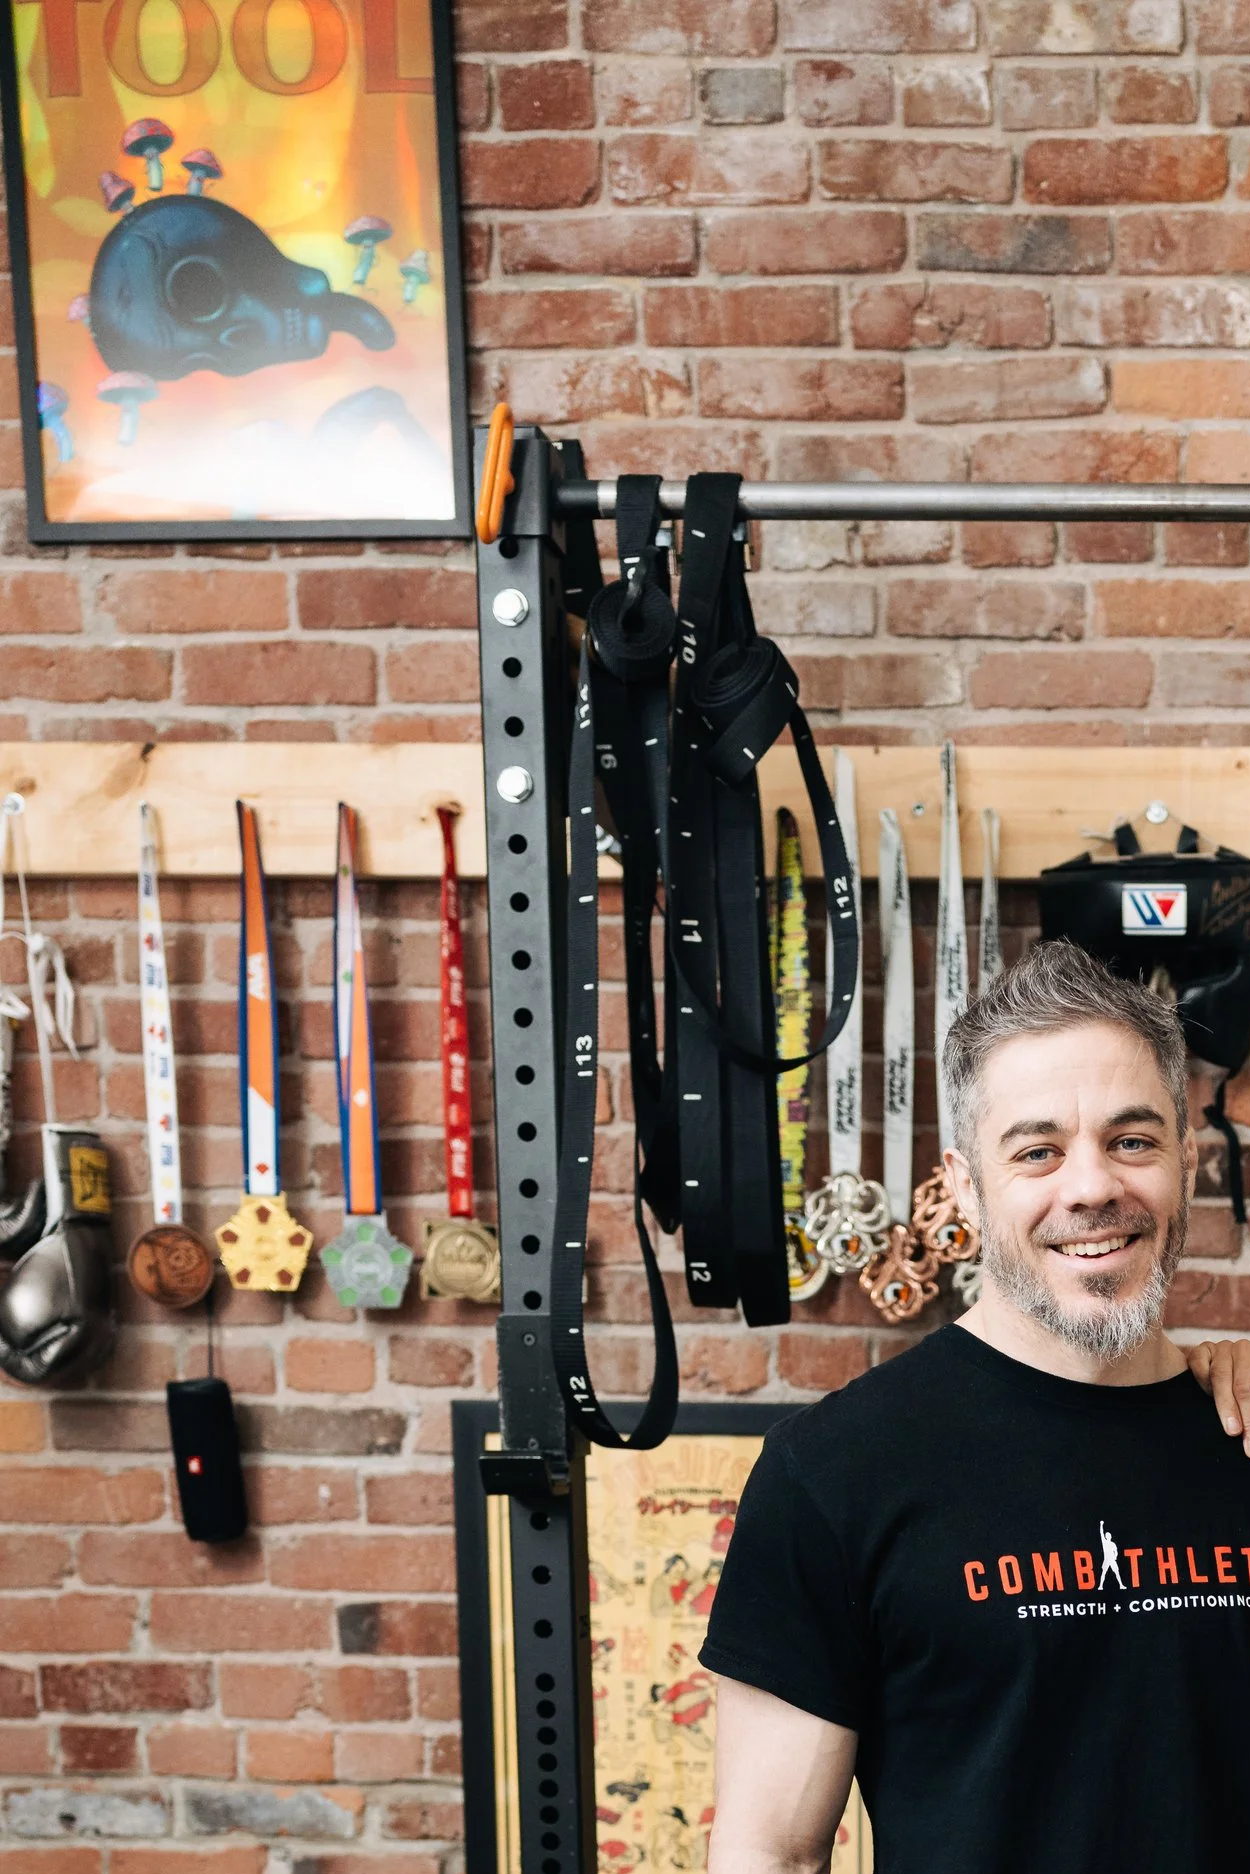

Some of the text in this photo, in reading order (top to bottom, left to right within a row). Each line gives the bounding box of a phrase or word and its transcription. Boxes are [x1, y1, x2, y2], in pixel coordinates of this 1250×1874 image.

[16, 0, 434, 99] TOOL
[575, 1034, 593, 1066] 13
[569, 1375, 590, 1403] 12
[1016, 1600, 1107, 1620] STRENGTH
